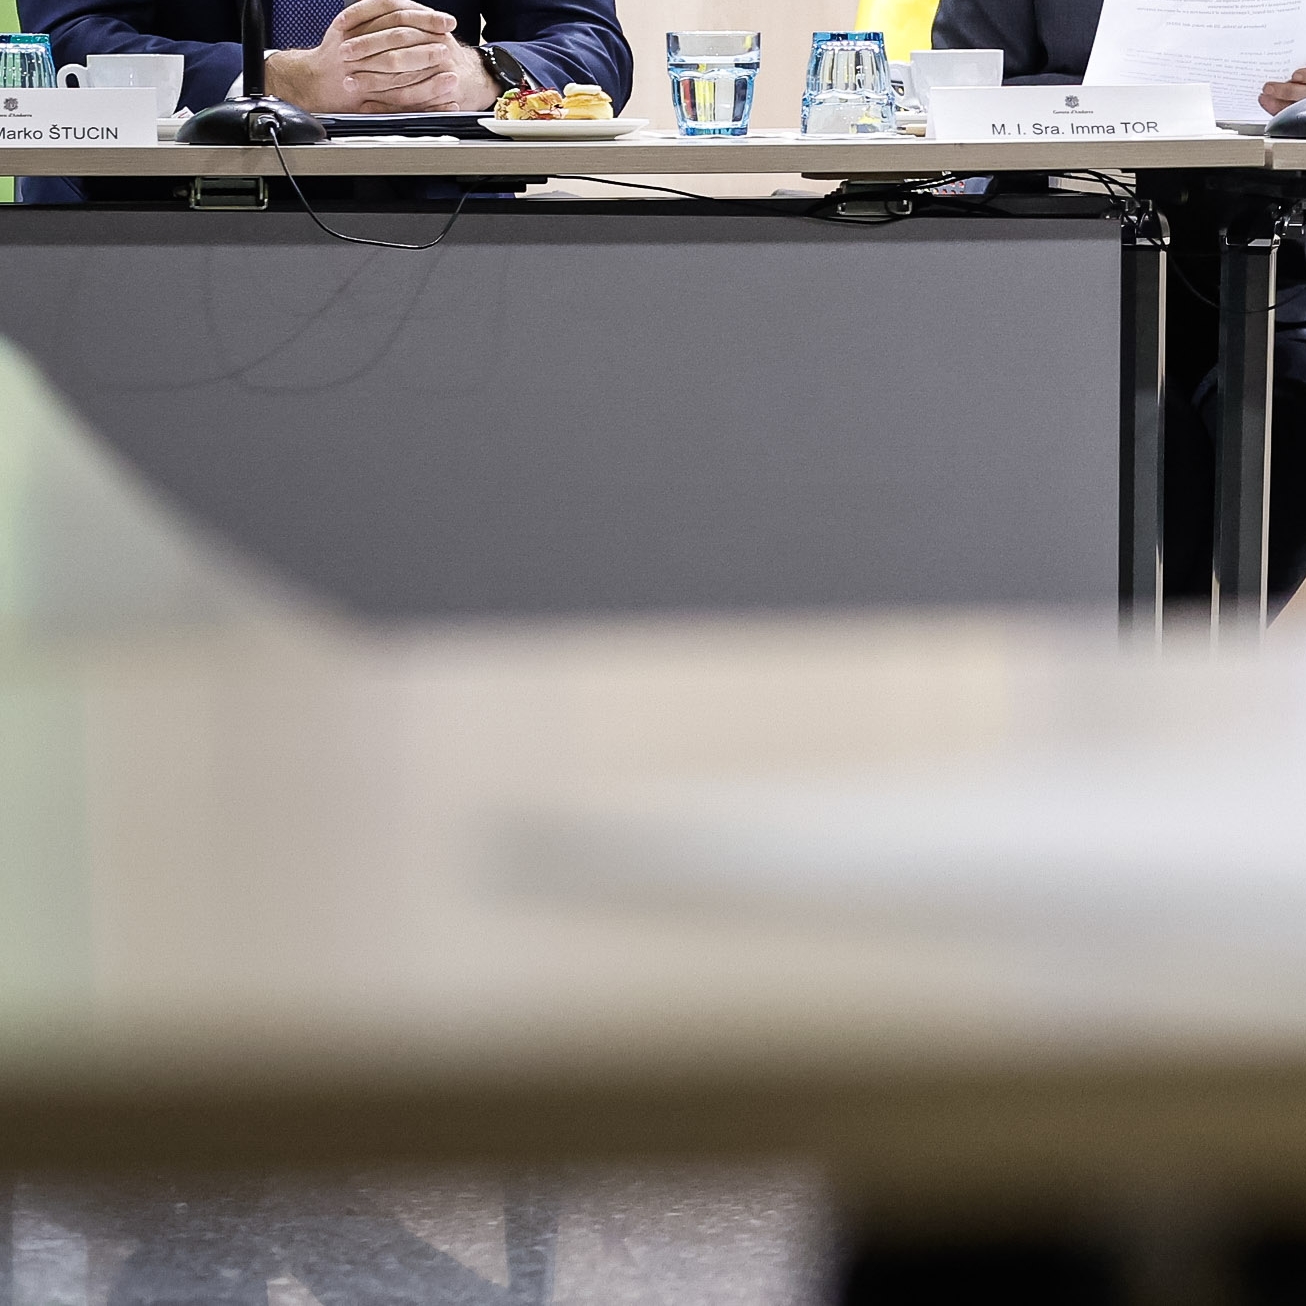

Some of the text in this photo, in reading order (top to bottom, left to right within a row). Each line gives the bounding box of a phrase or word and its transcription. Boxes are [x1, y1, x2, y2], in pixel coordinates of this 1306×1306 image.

[49, 124, 119, 140] ŠTUCIN
[991, 121, 1160, 135] M. I. Sra. Imma TOR
